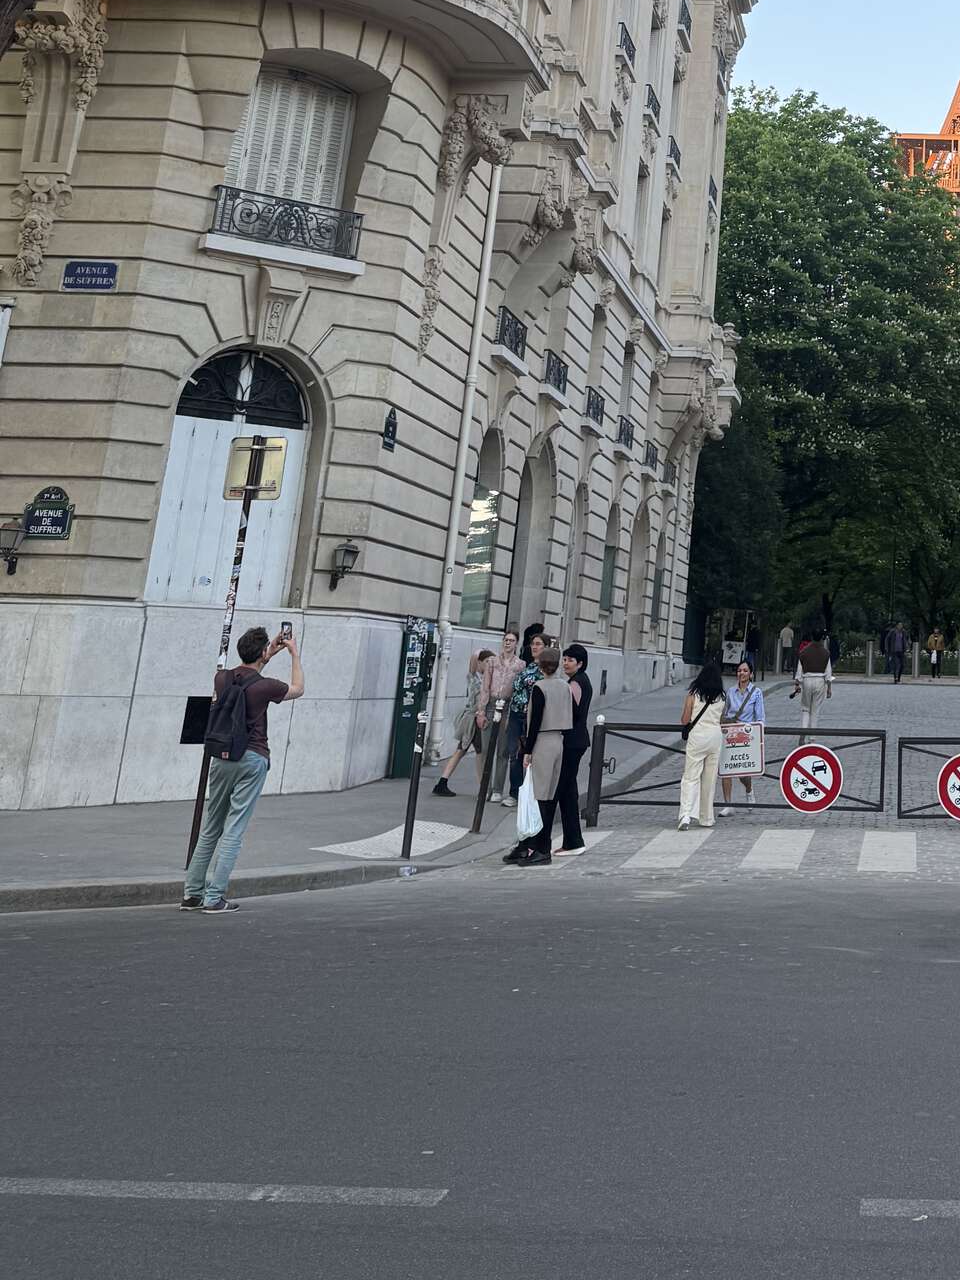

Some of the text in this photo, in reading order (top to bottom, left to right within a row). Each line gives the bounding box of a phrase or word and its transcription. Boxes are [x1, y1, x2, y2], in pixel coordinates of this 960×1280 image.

[75, 266, 109, 274] AVENUE
[64, 276, 115, 285] DE SUFFREN
[34, 509, 64, 518] AVENUE
[41, 517, 52, 526] DE
[28, 525, 63, 534] SUFFREN
[724, 761, 756, 769] POMPIERS
